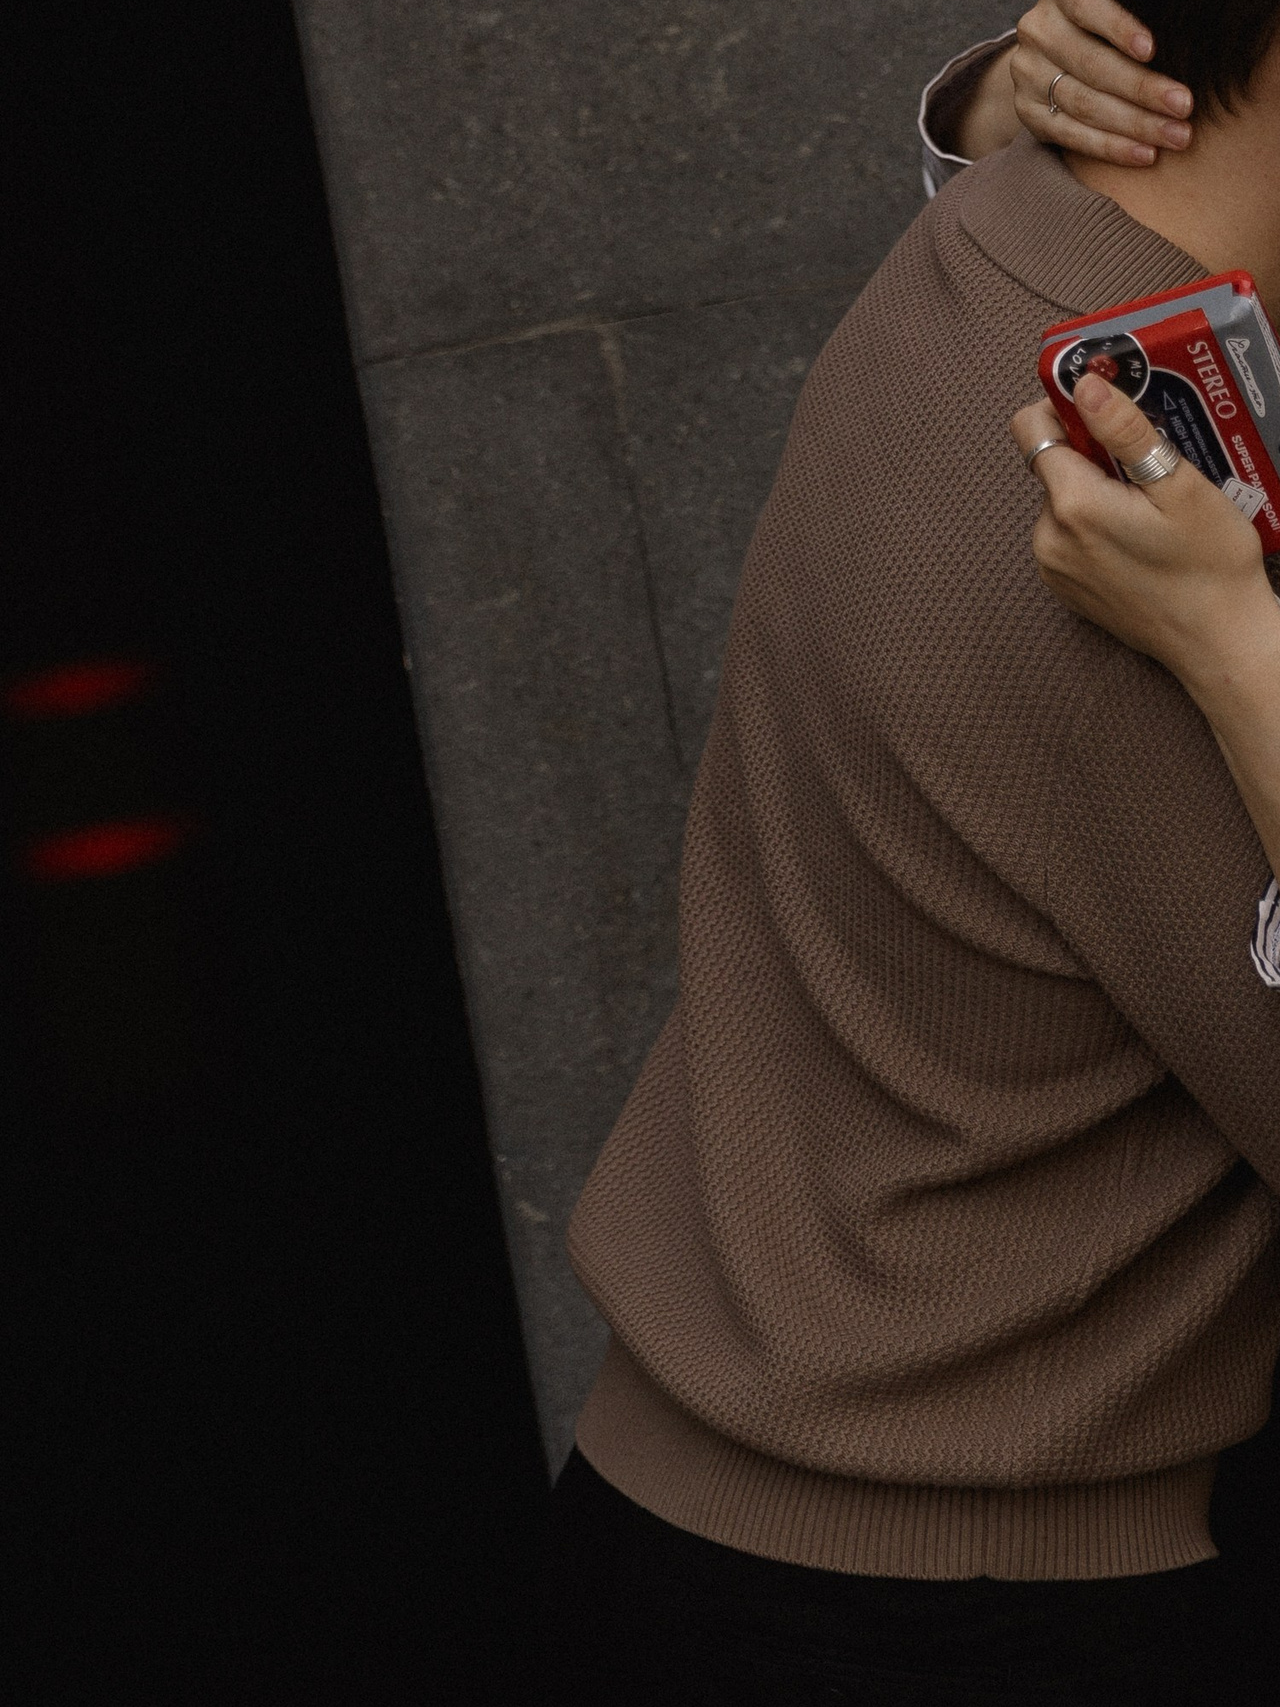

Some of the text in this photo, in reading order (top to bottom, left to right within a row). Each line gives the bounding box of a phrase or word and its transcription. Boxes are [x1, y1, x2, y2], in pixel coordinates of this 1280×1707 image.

[1187, 341, 1238, 419] STEREO
[1170, 416, 1188, 439] HIGH
[1179, 398, 1194, 421] STEREO
[1190, 423, 1208, 456] PERSONAL
[1230, 435, 1254, 472] SUPER
